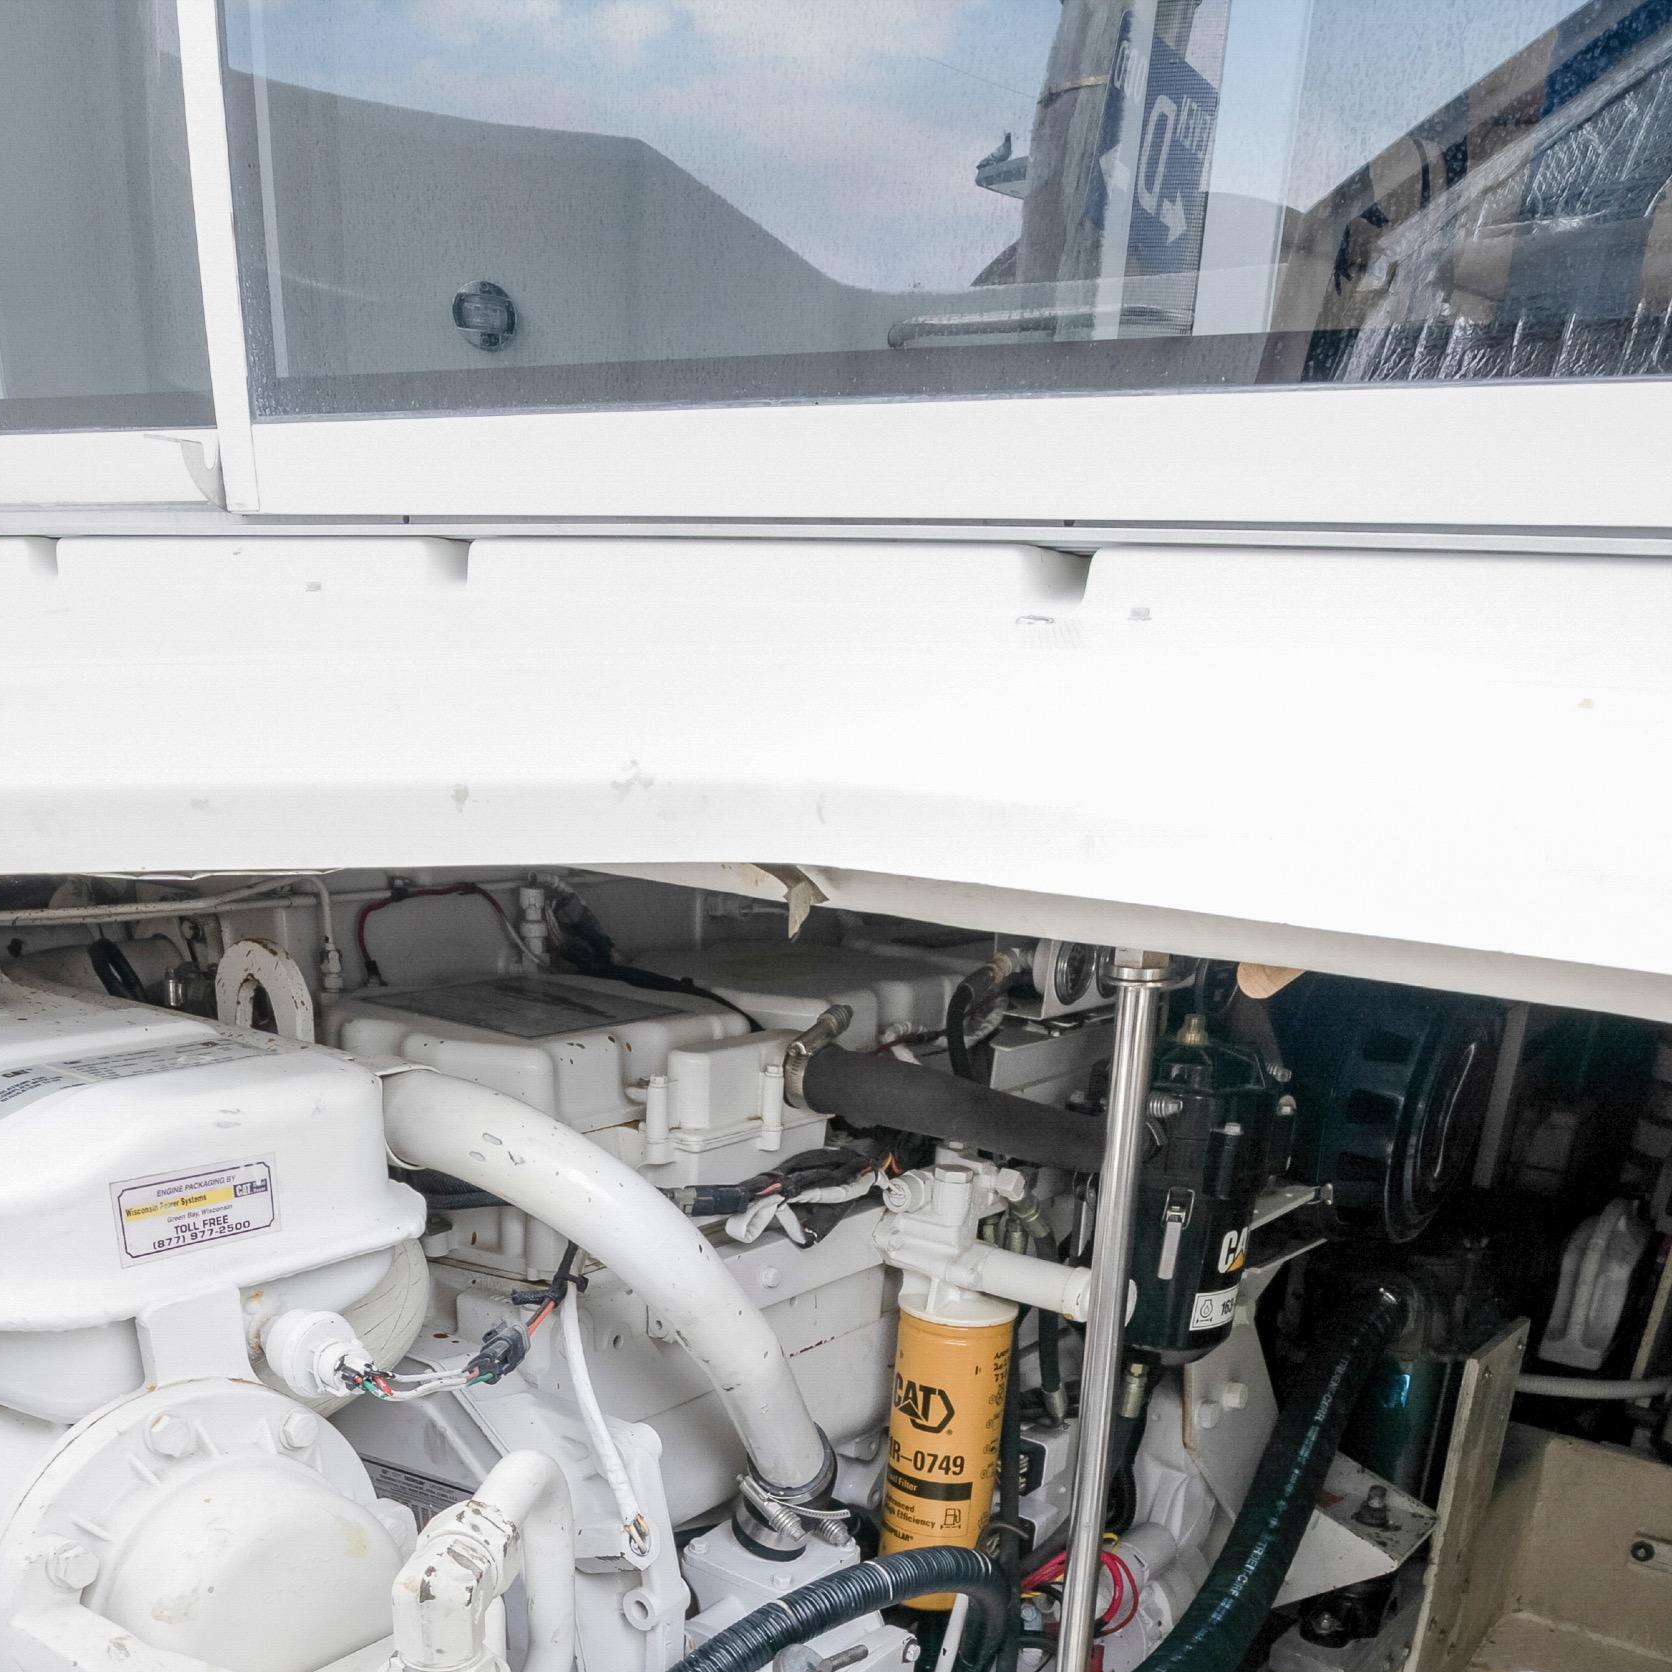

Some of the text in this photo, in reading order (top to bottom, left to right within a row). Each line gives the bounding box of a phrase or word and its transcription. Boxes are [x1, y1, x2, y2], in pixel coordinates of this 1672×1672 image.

[156, 1174, 237, 1197] ENGINE PACKAGING BY
[125, 1204, 159, 1218] Wisconsin
[180, 1193, 207, 1207] Systems
[167, 1212, 185, 1223] Green
[201, 1204, 233, 1216] Wisconsin
[153, 1220, 251, 1250] (877) 977-2500
[173, 1215, 229, 1235] TOLL FREE
[893, 1371, 937, 1422] CAT
[897, 1476, 918, 1492] Filter
[896, 1509, 936, 1530] Efficiency
